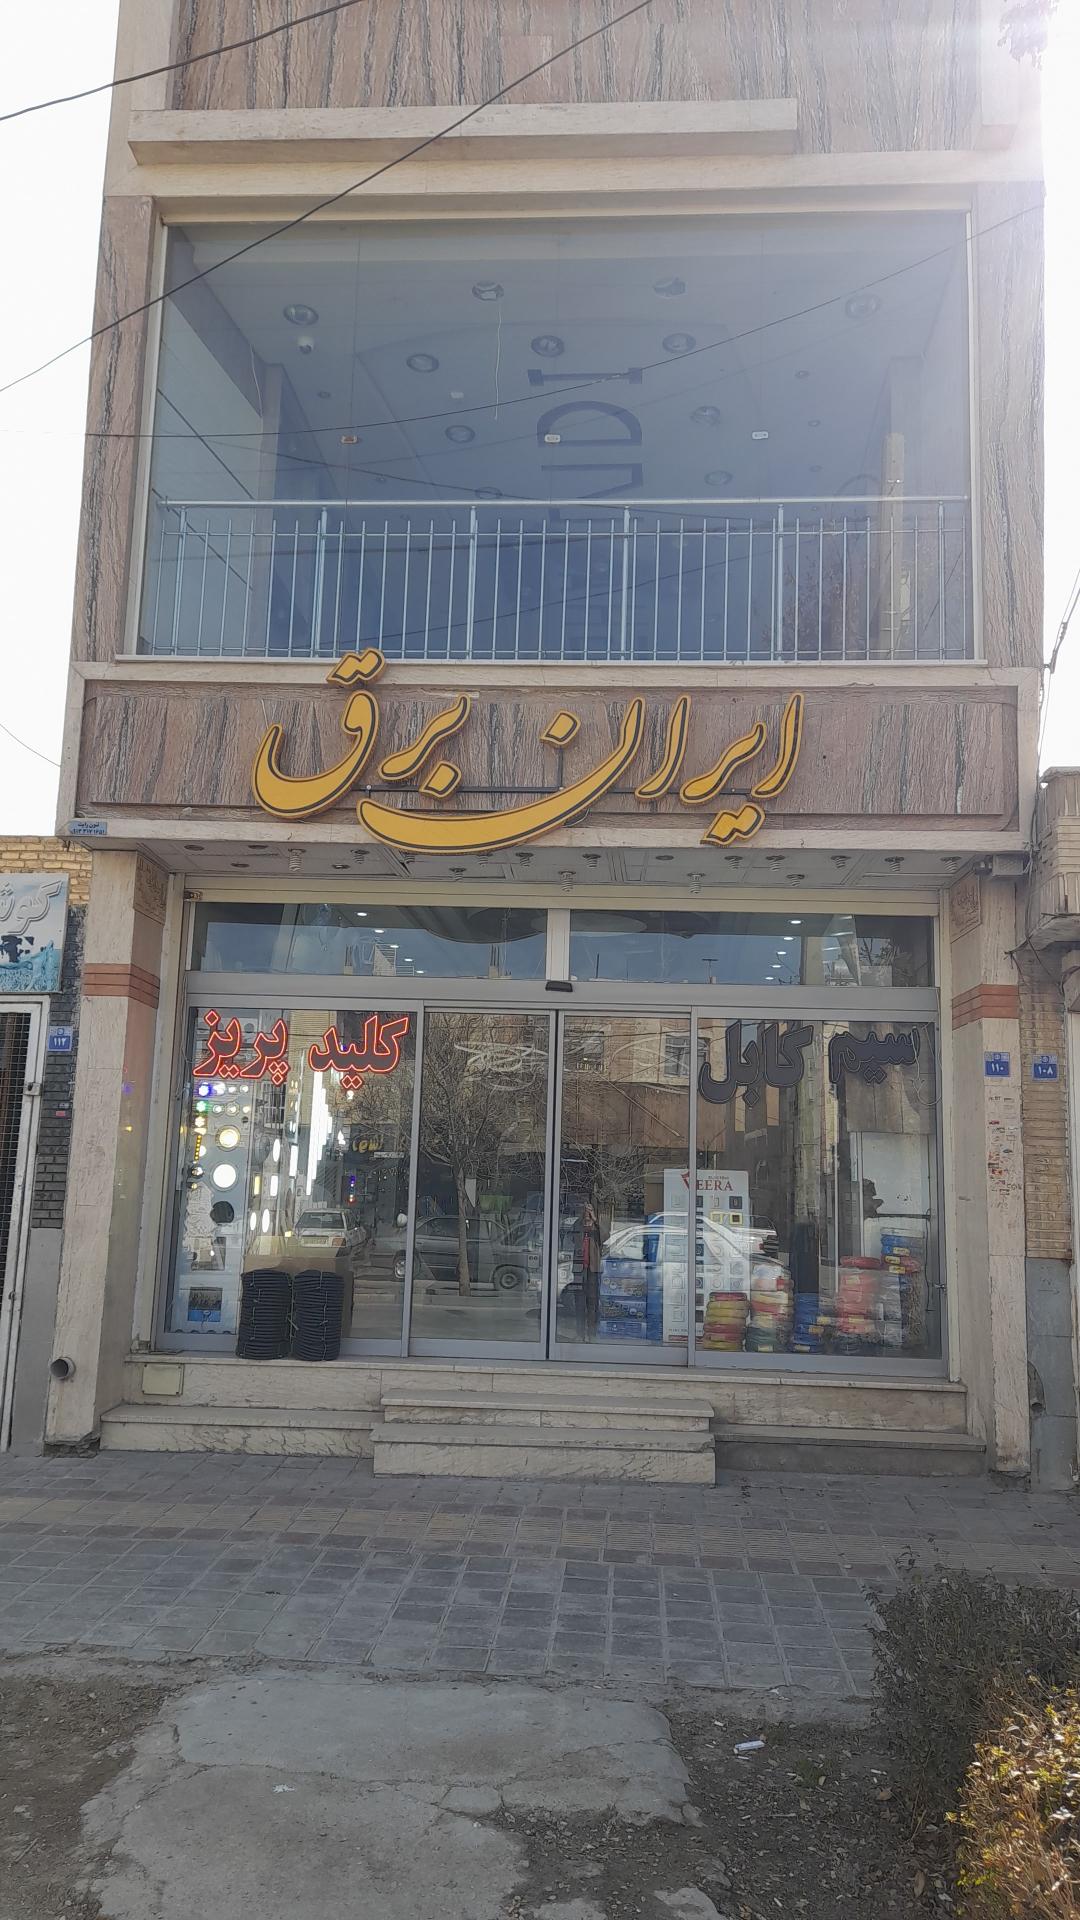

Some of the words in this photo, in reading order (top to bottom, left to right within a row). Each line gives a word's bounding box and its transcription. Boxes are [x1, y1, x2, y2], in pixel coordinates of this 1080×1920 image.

[253, 647, 471, 819] برق
[356, 693, 804, 855] ایران
[192, 1009, 290, 1087] پریز
[308, 1012, 410, 1091] کلید
[699, 1020, 814, 1107] کابل
[828, 1028, 921, 1085] سیم
[991, 1062, 1004, 1073] ۱۱۰
[1038, 1065, 1053, 1075] ۱۰۸
